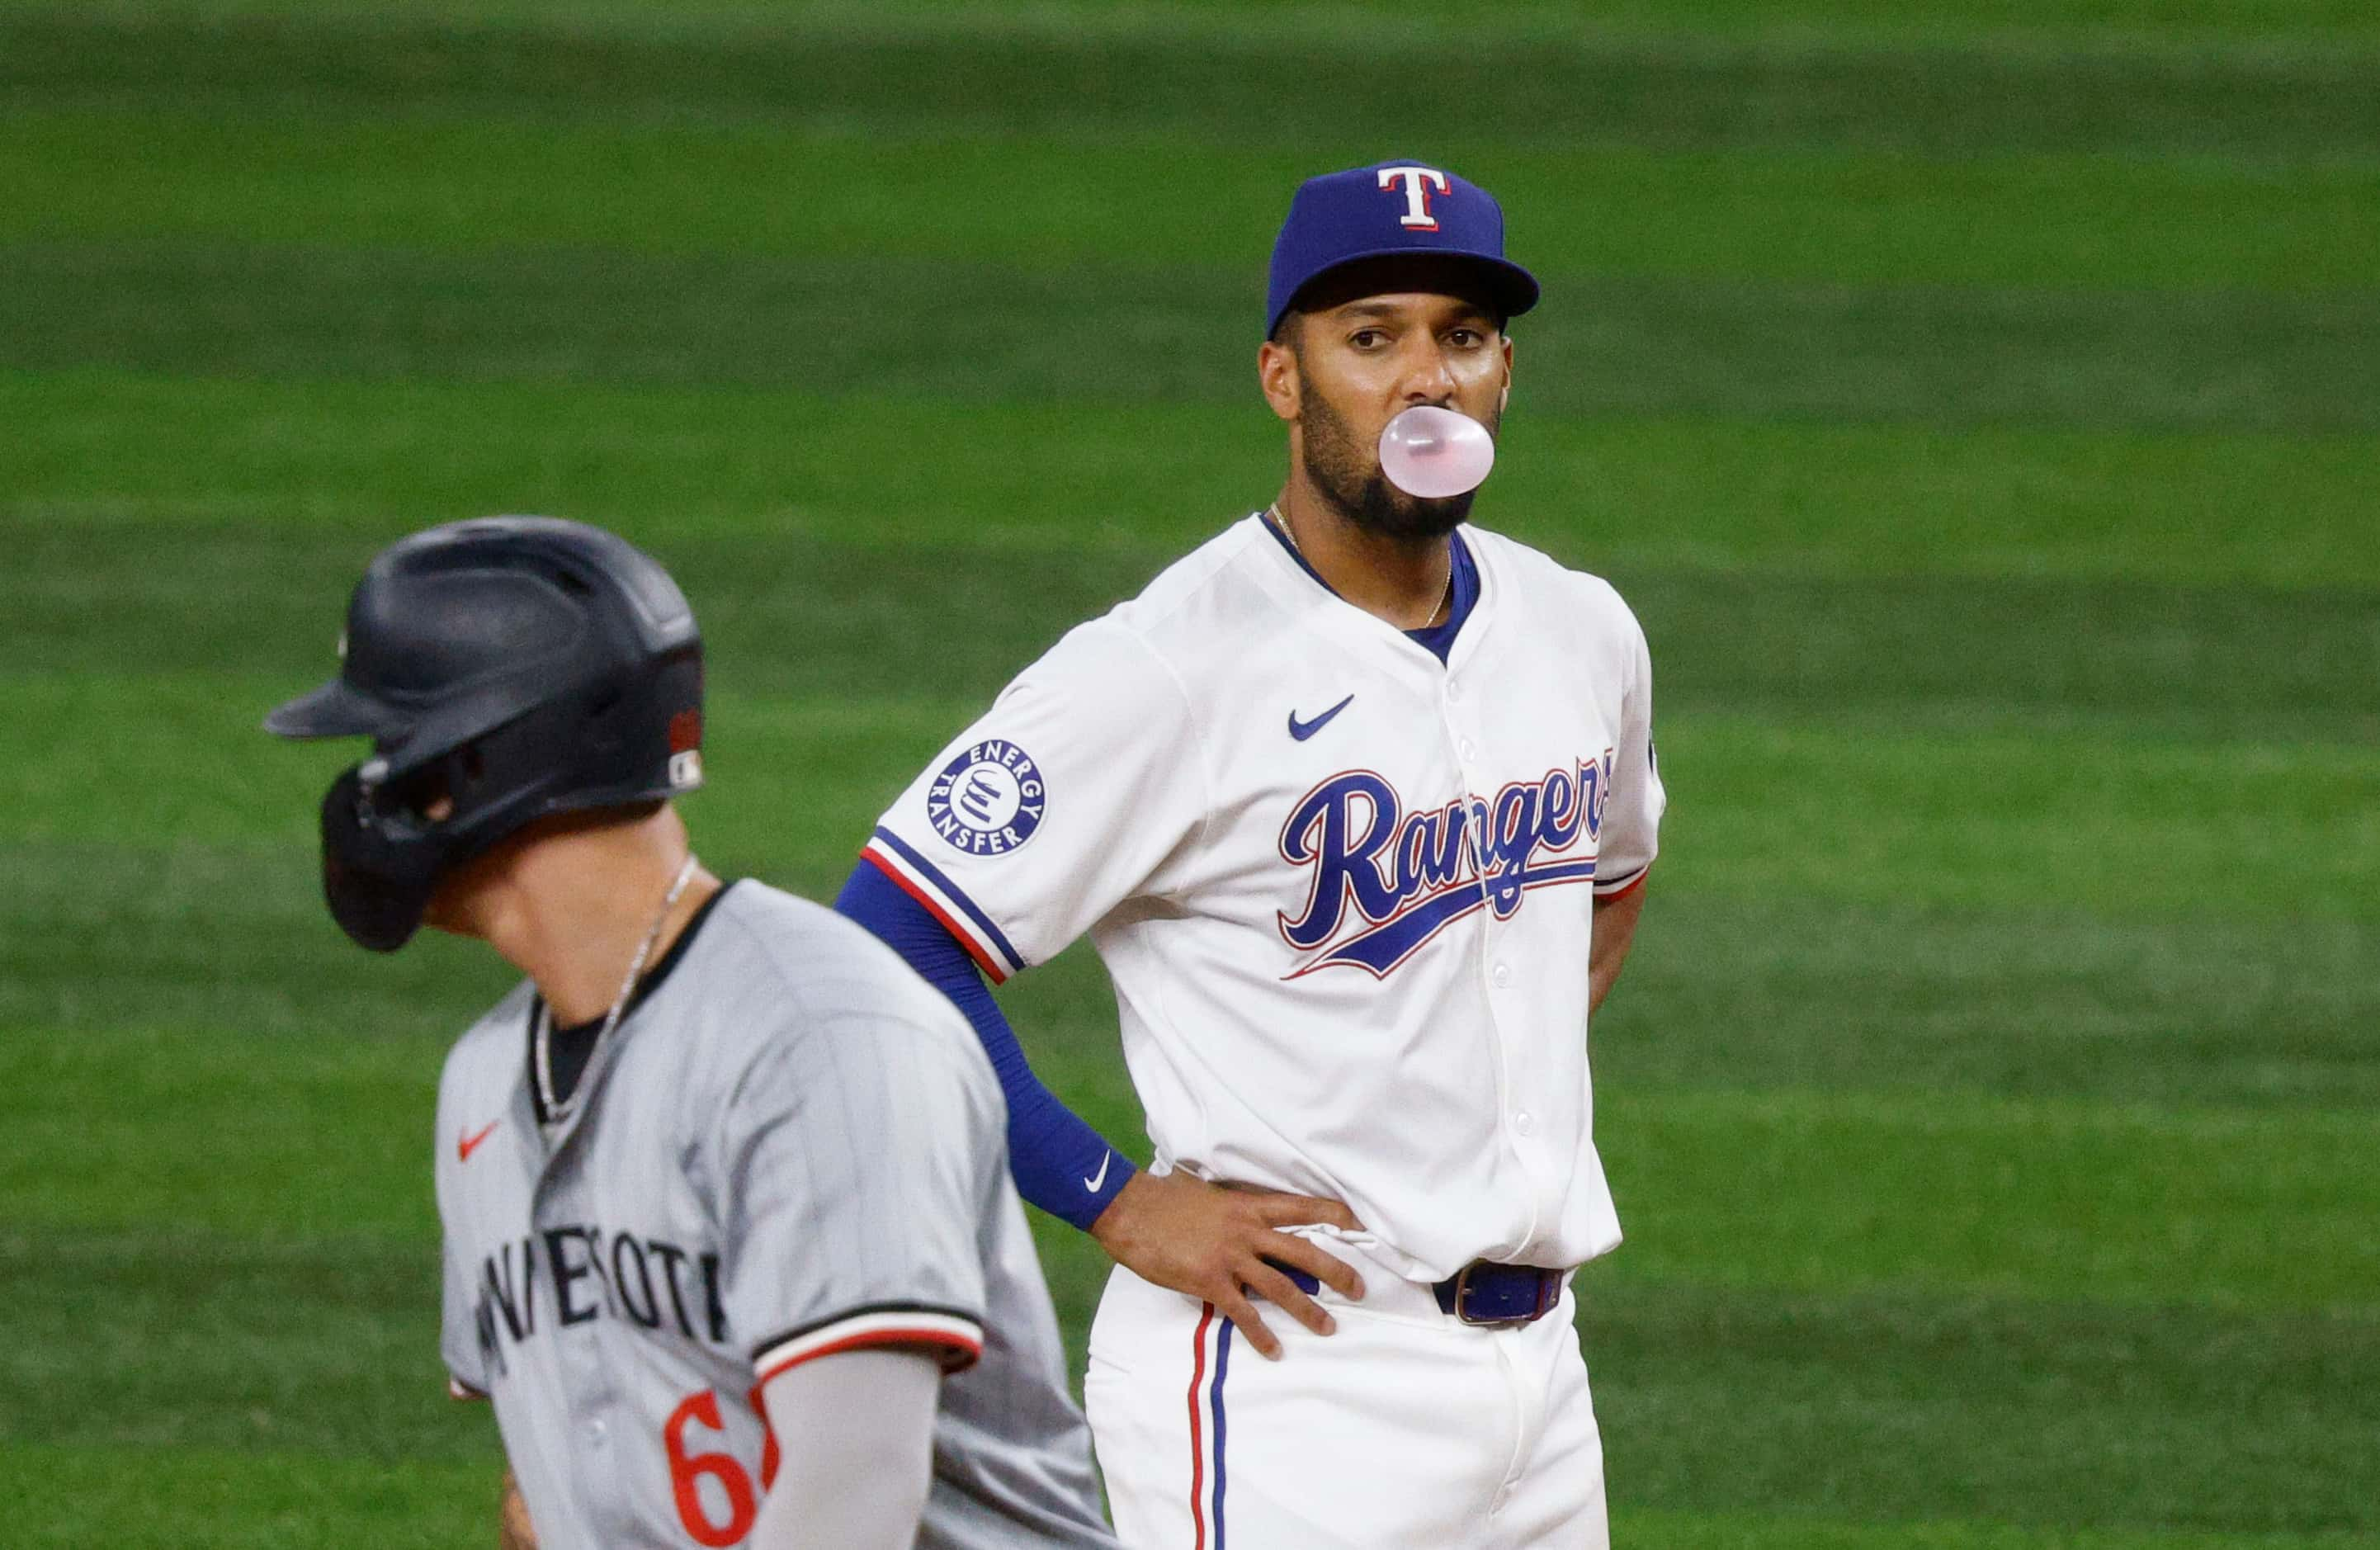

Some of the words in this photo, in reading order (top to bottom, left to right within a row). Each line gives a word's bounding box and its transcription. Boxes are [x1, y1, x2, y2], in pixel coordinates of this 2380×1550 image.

[1377, 167, 1452, 232] T
[928, 773, 1022, 853] TRANSFER
[970, 741, 1042, 820] ENERGY
[664, 1387, 781, 1548] 6
